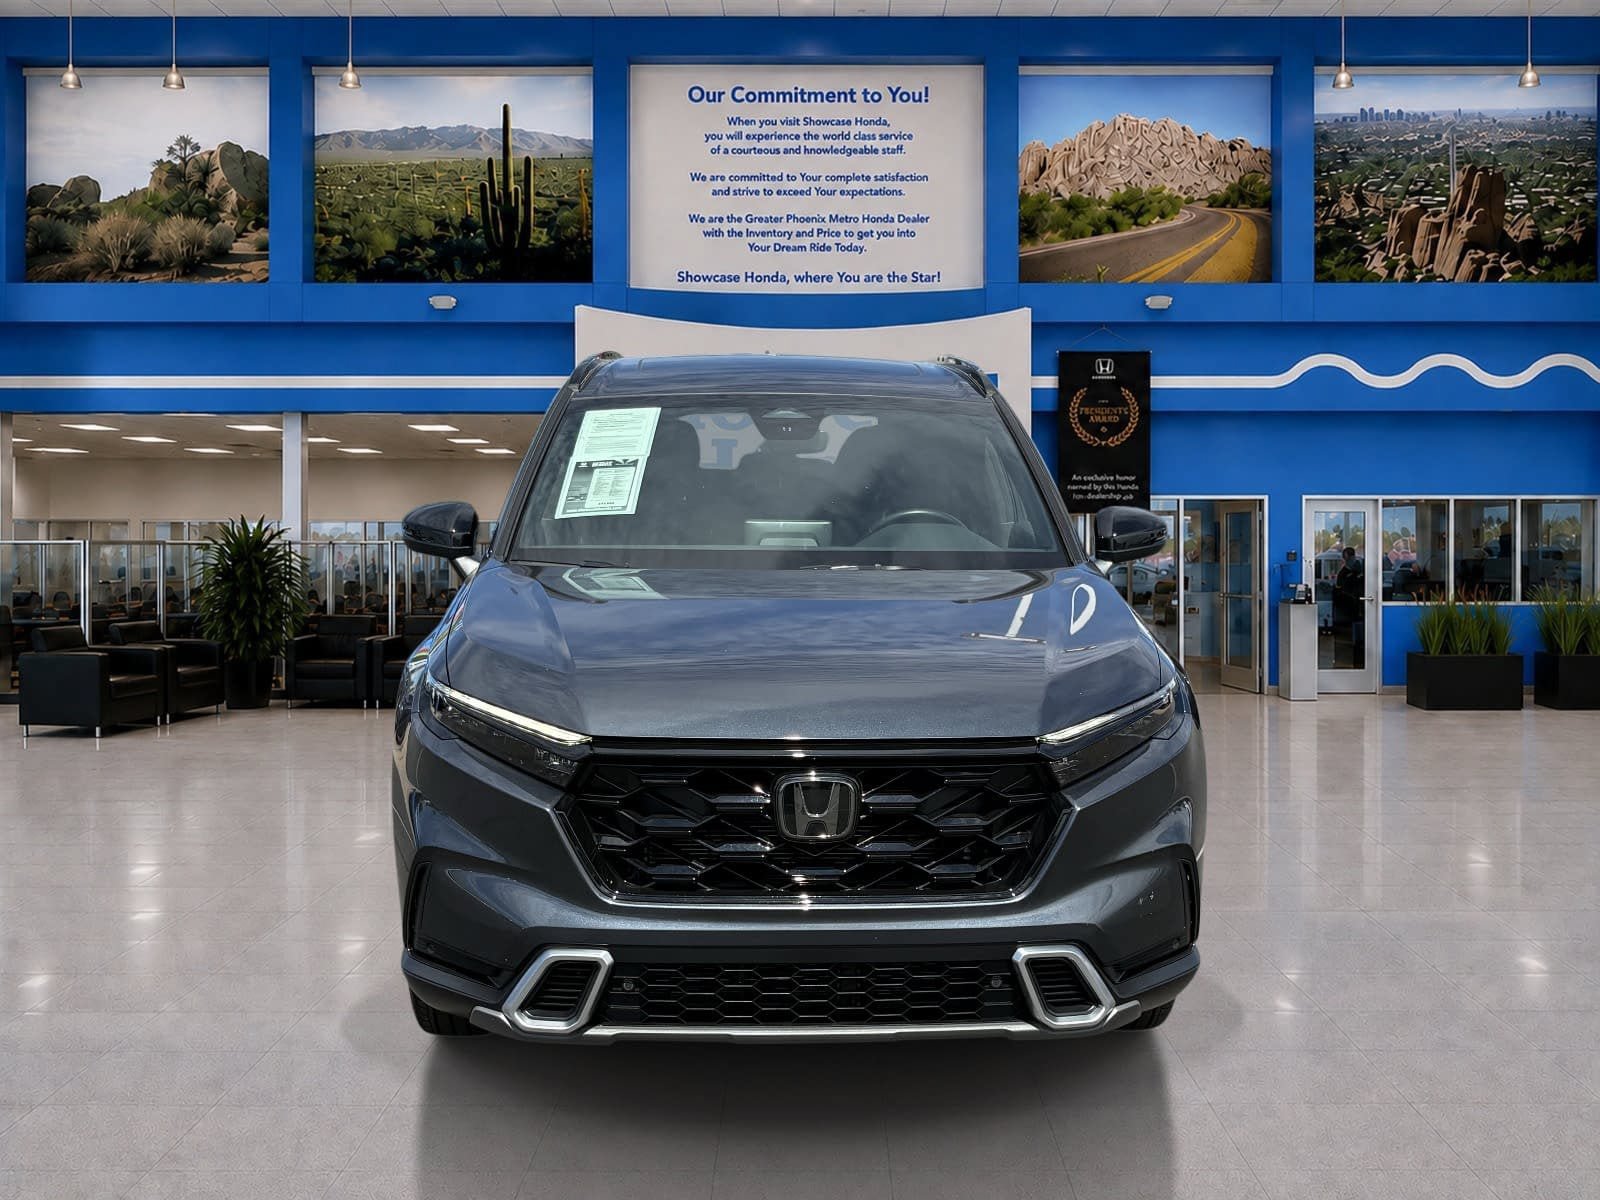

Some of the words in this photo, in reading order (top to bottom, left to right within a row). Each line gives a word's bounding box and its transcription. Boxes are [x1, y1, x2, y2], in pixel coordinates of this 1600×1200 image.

[688, 86, 726, 103] Our
[731, 86, 856, 103] Commitment
[861, 88, 882, 103] to
[887, 86, 929, 103] You!
[727, 116, 756, 126] When
[759, 119, 777, 128] you
[780, 117, 800, 126] visit
[803, 116, 852, 126] Showcase
[855, 117, 890, 127] Honda,
[705, 134, 723, 144] you
[725, 131, 743, 140] will
[745, 131, 800, 143] experience
[803, 131, 820, 140] the
[822, 131, 851, 141] world
[853, 131, 876, 141] class
[879, 132, 914, 141] service
[710, 145, 721, 155] of
[731, 146, 781, 155] courteous
[783, 145, 801, 155] and
[882, 144, 906, 155] staff.
[690, 172, 707, 182] We
[728, 172, 783, 182] committed
[786, 174, 797, 182] to
[800, 172, 822, 182] Your
[825, 172, 871, 185] complete
[874, 172, 928, 182] satisfaction
[712, 186, 731, 196] and
[732, 187, 760, 196] strive
[763, 188, 774, 196] to
[776, 187, 812, 196] exceed
[814, 187, 838, 196] Your
[839, 187, 905, 199] expectations.
[688, 214, 706, 224] We
[708, 216, 724, 224] are
[726, 213, 743, 223] the
[745, 214, 784, 224] Greater
[786, 214, 826, 223] Phoenix
[829, 214, 859, 223] Metro
[862, 214, 895, 223] Honda
[897, 213, 930, 224] Dealer
[702, 228, 724, 238] with
[727, 228, 744, 238] the
[746, 228, 793, 240] Inventory
[795, 228, 814, 238] and
[817, 228, 841, 238] Price
[844, 230, 854, 238] to
[857, 229, 874, 240] get
[876, 230, 894, 240] you
[897, 228, 916, 238] into
[748, 242, 771, 252] Your
[773, 243, 807, 252] Dream
[810, 242, 832, 252] Ride
[834, 242, 867, 255] Today.
[677, 271, 740, 283] Showcase
[745, 271, 790, 285] Honda,
[794, 271, 833, 283] where
[837, 272, 860, 283] You
[864, 274, 883, 283] are
[887, 271, 908, 283] the
[911, 271, 940, 283] Star!
[1093, 484, 1102, 492] by
